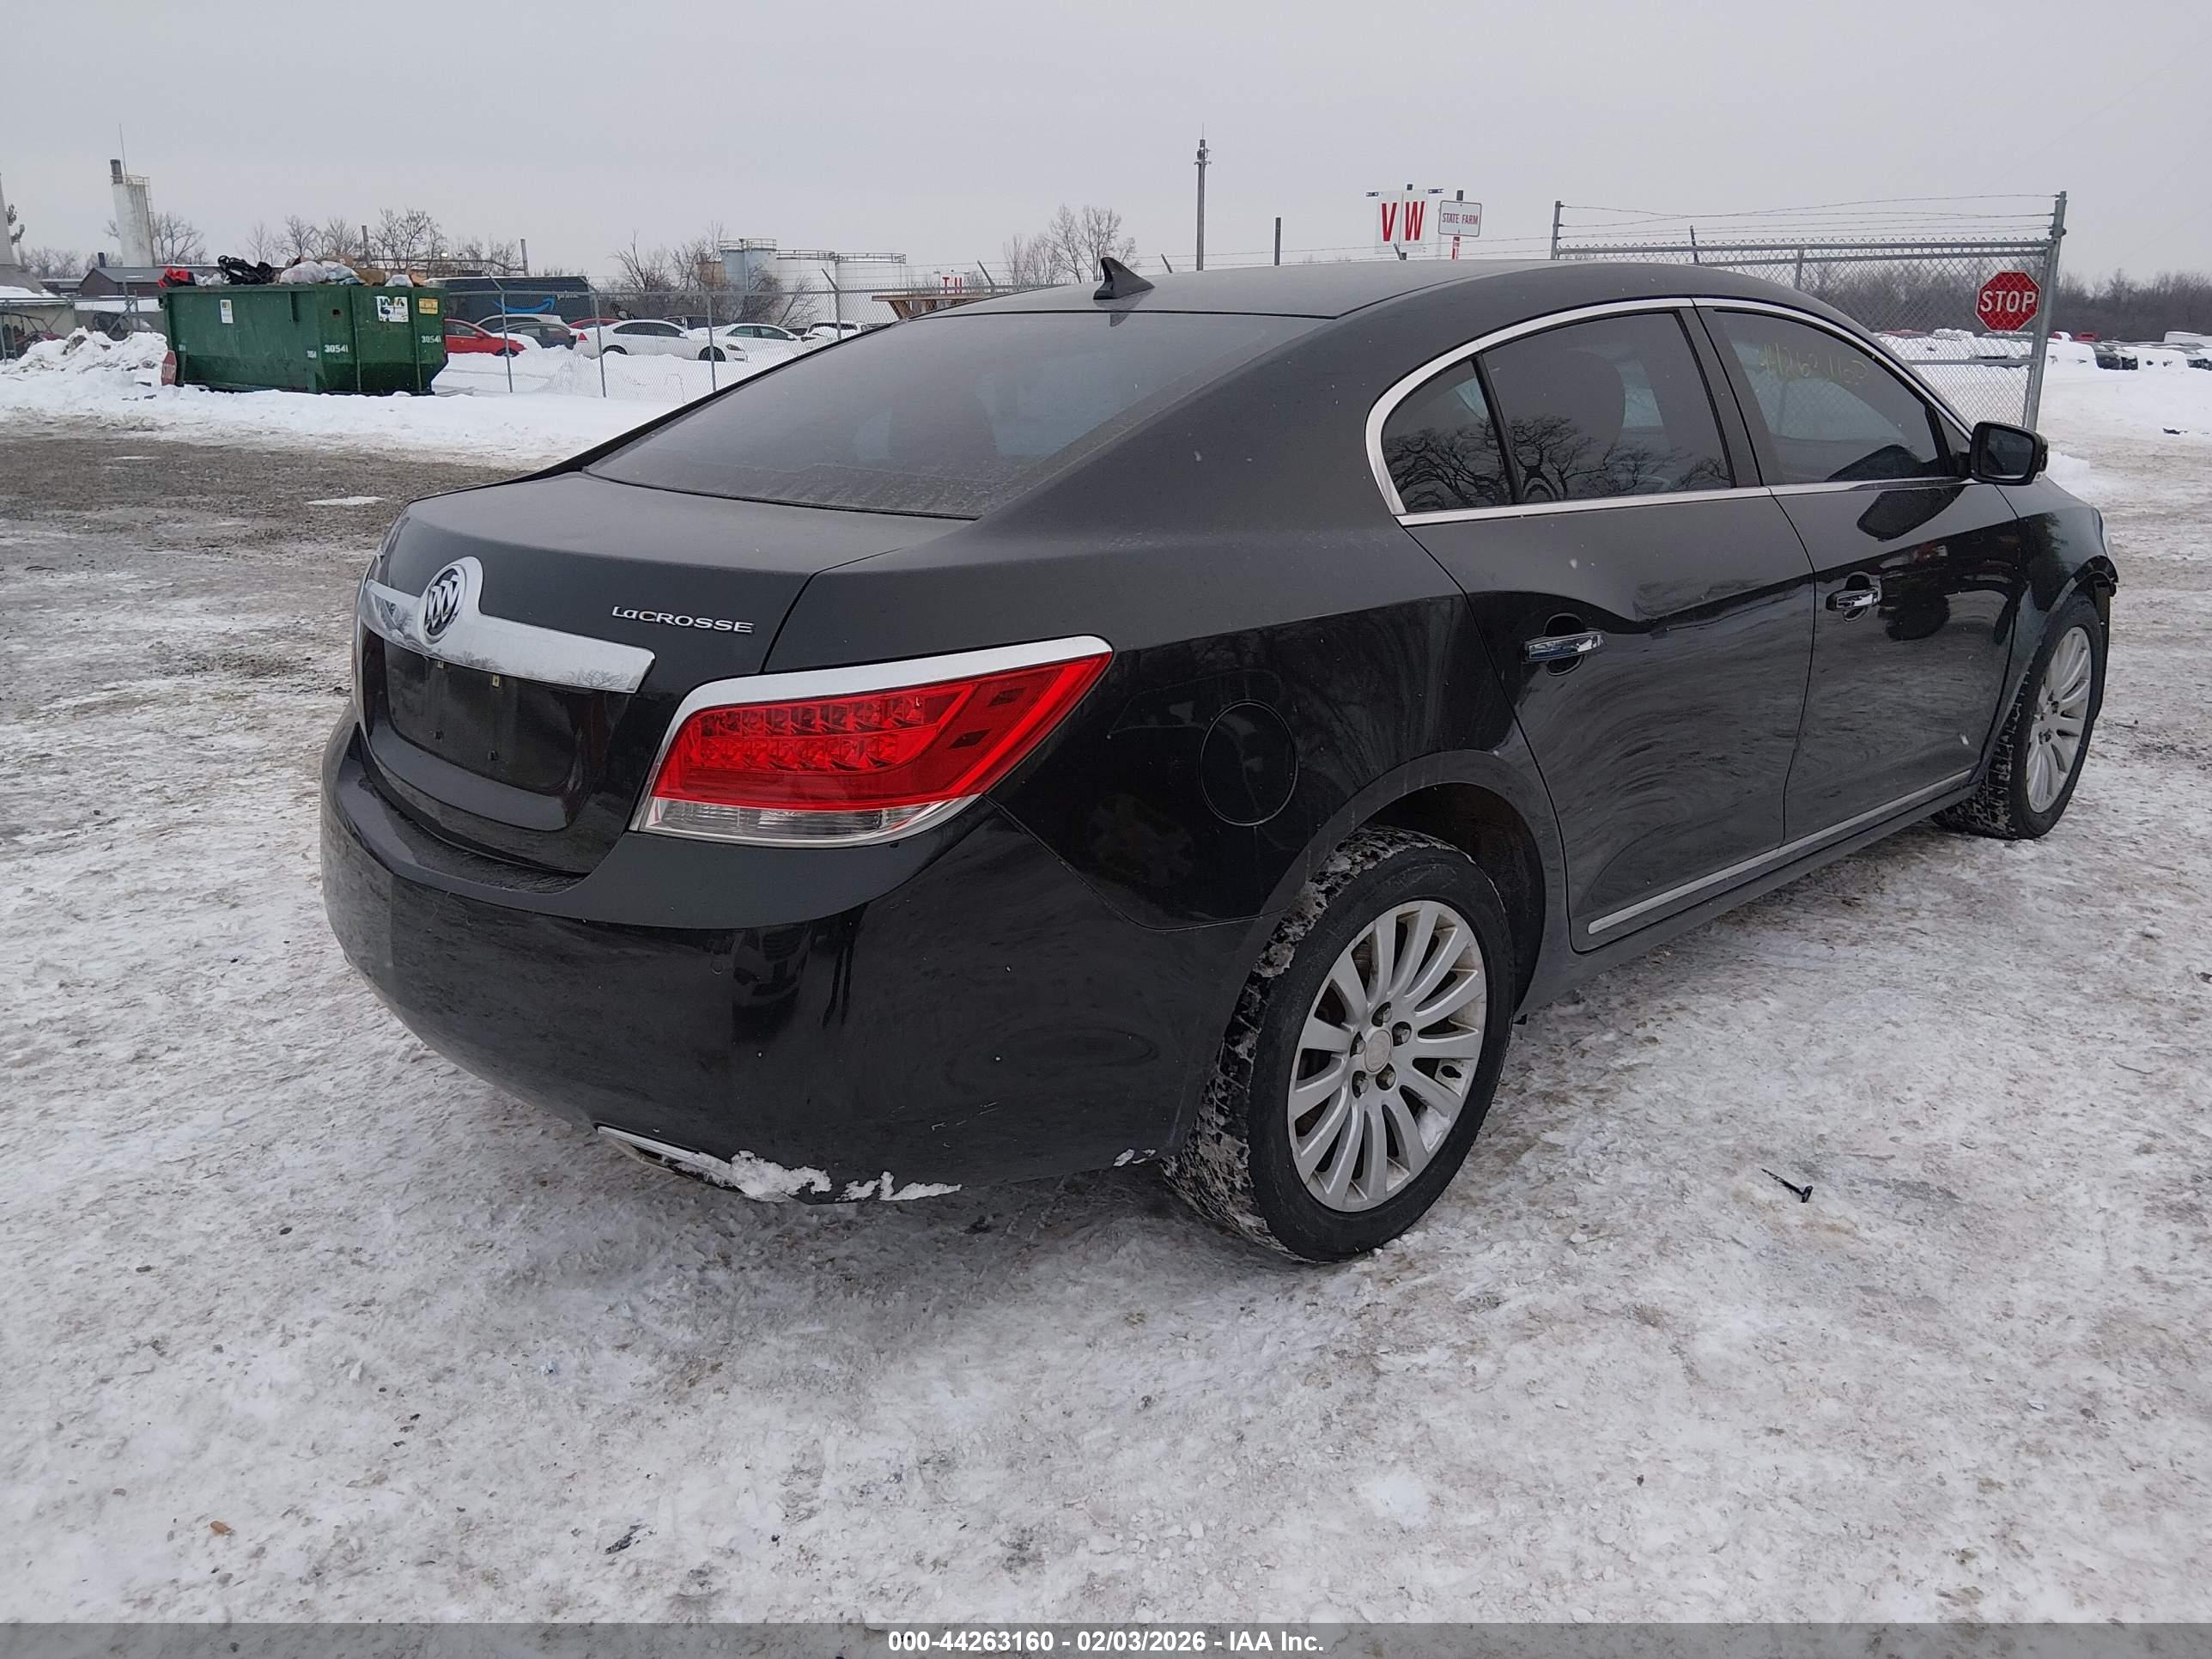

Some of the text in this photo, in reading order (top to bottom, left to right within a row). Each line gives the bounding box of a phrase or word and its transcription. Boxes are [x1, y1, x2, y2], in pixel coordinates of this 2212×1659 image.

[1442, 213, 1479, 225] STATE FARM
[1979, 290, 2036, 313] STOP
[324, 344, 349, 353] 30541
[612, 606, 755, 634] LaCROSSE
